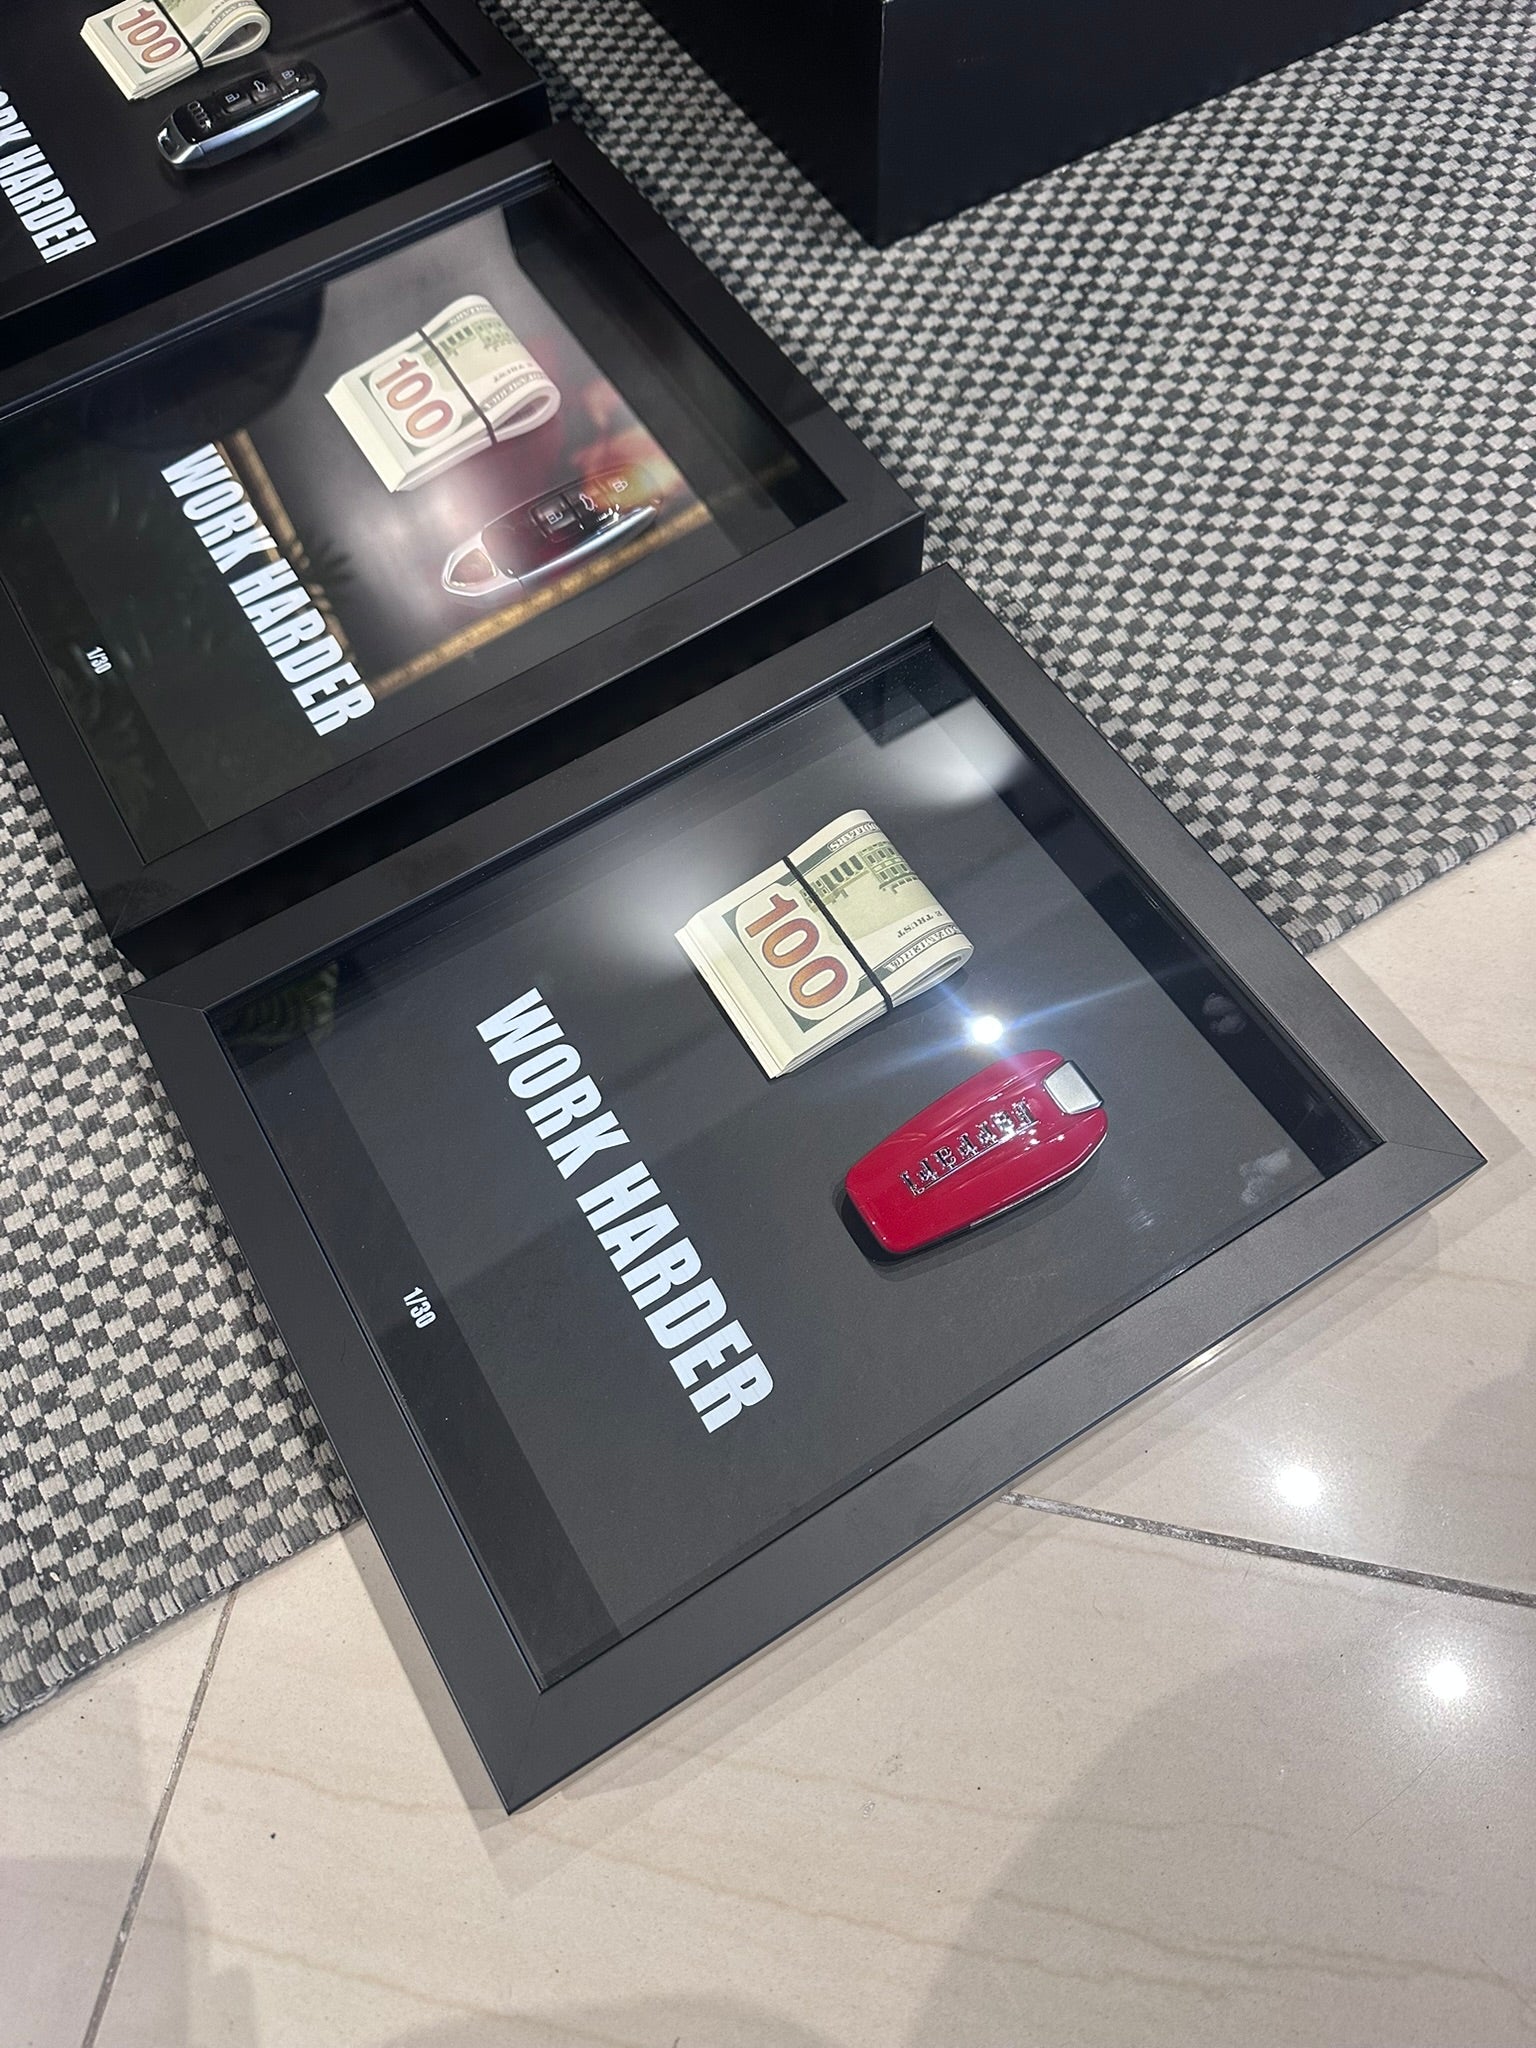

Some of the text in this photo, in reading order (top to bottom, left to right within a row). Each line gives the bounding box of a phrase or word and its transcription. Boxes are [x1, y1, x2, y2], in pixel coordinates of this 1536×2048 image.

[118, 7, 182, 64] 100
[0, 144, 97, 264] HARDER
[374, 357, 455, 440] 100
[161, 443, 376, 737] WORK HARDER
[86, 646, 112, 675] 1/30
[744, 893, 849, 1009] 100
[897, 914, 934, 938] TRUST
[899, 1096, 1041, 1197] Ferrari
[475, 987, 774, 1434] WORK HARDER
[403, 1286, 437, 1329] 1/30
